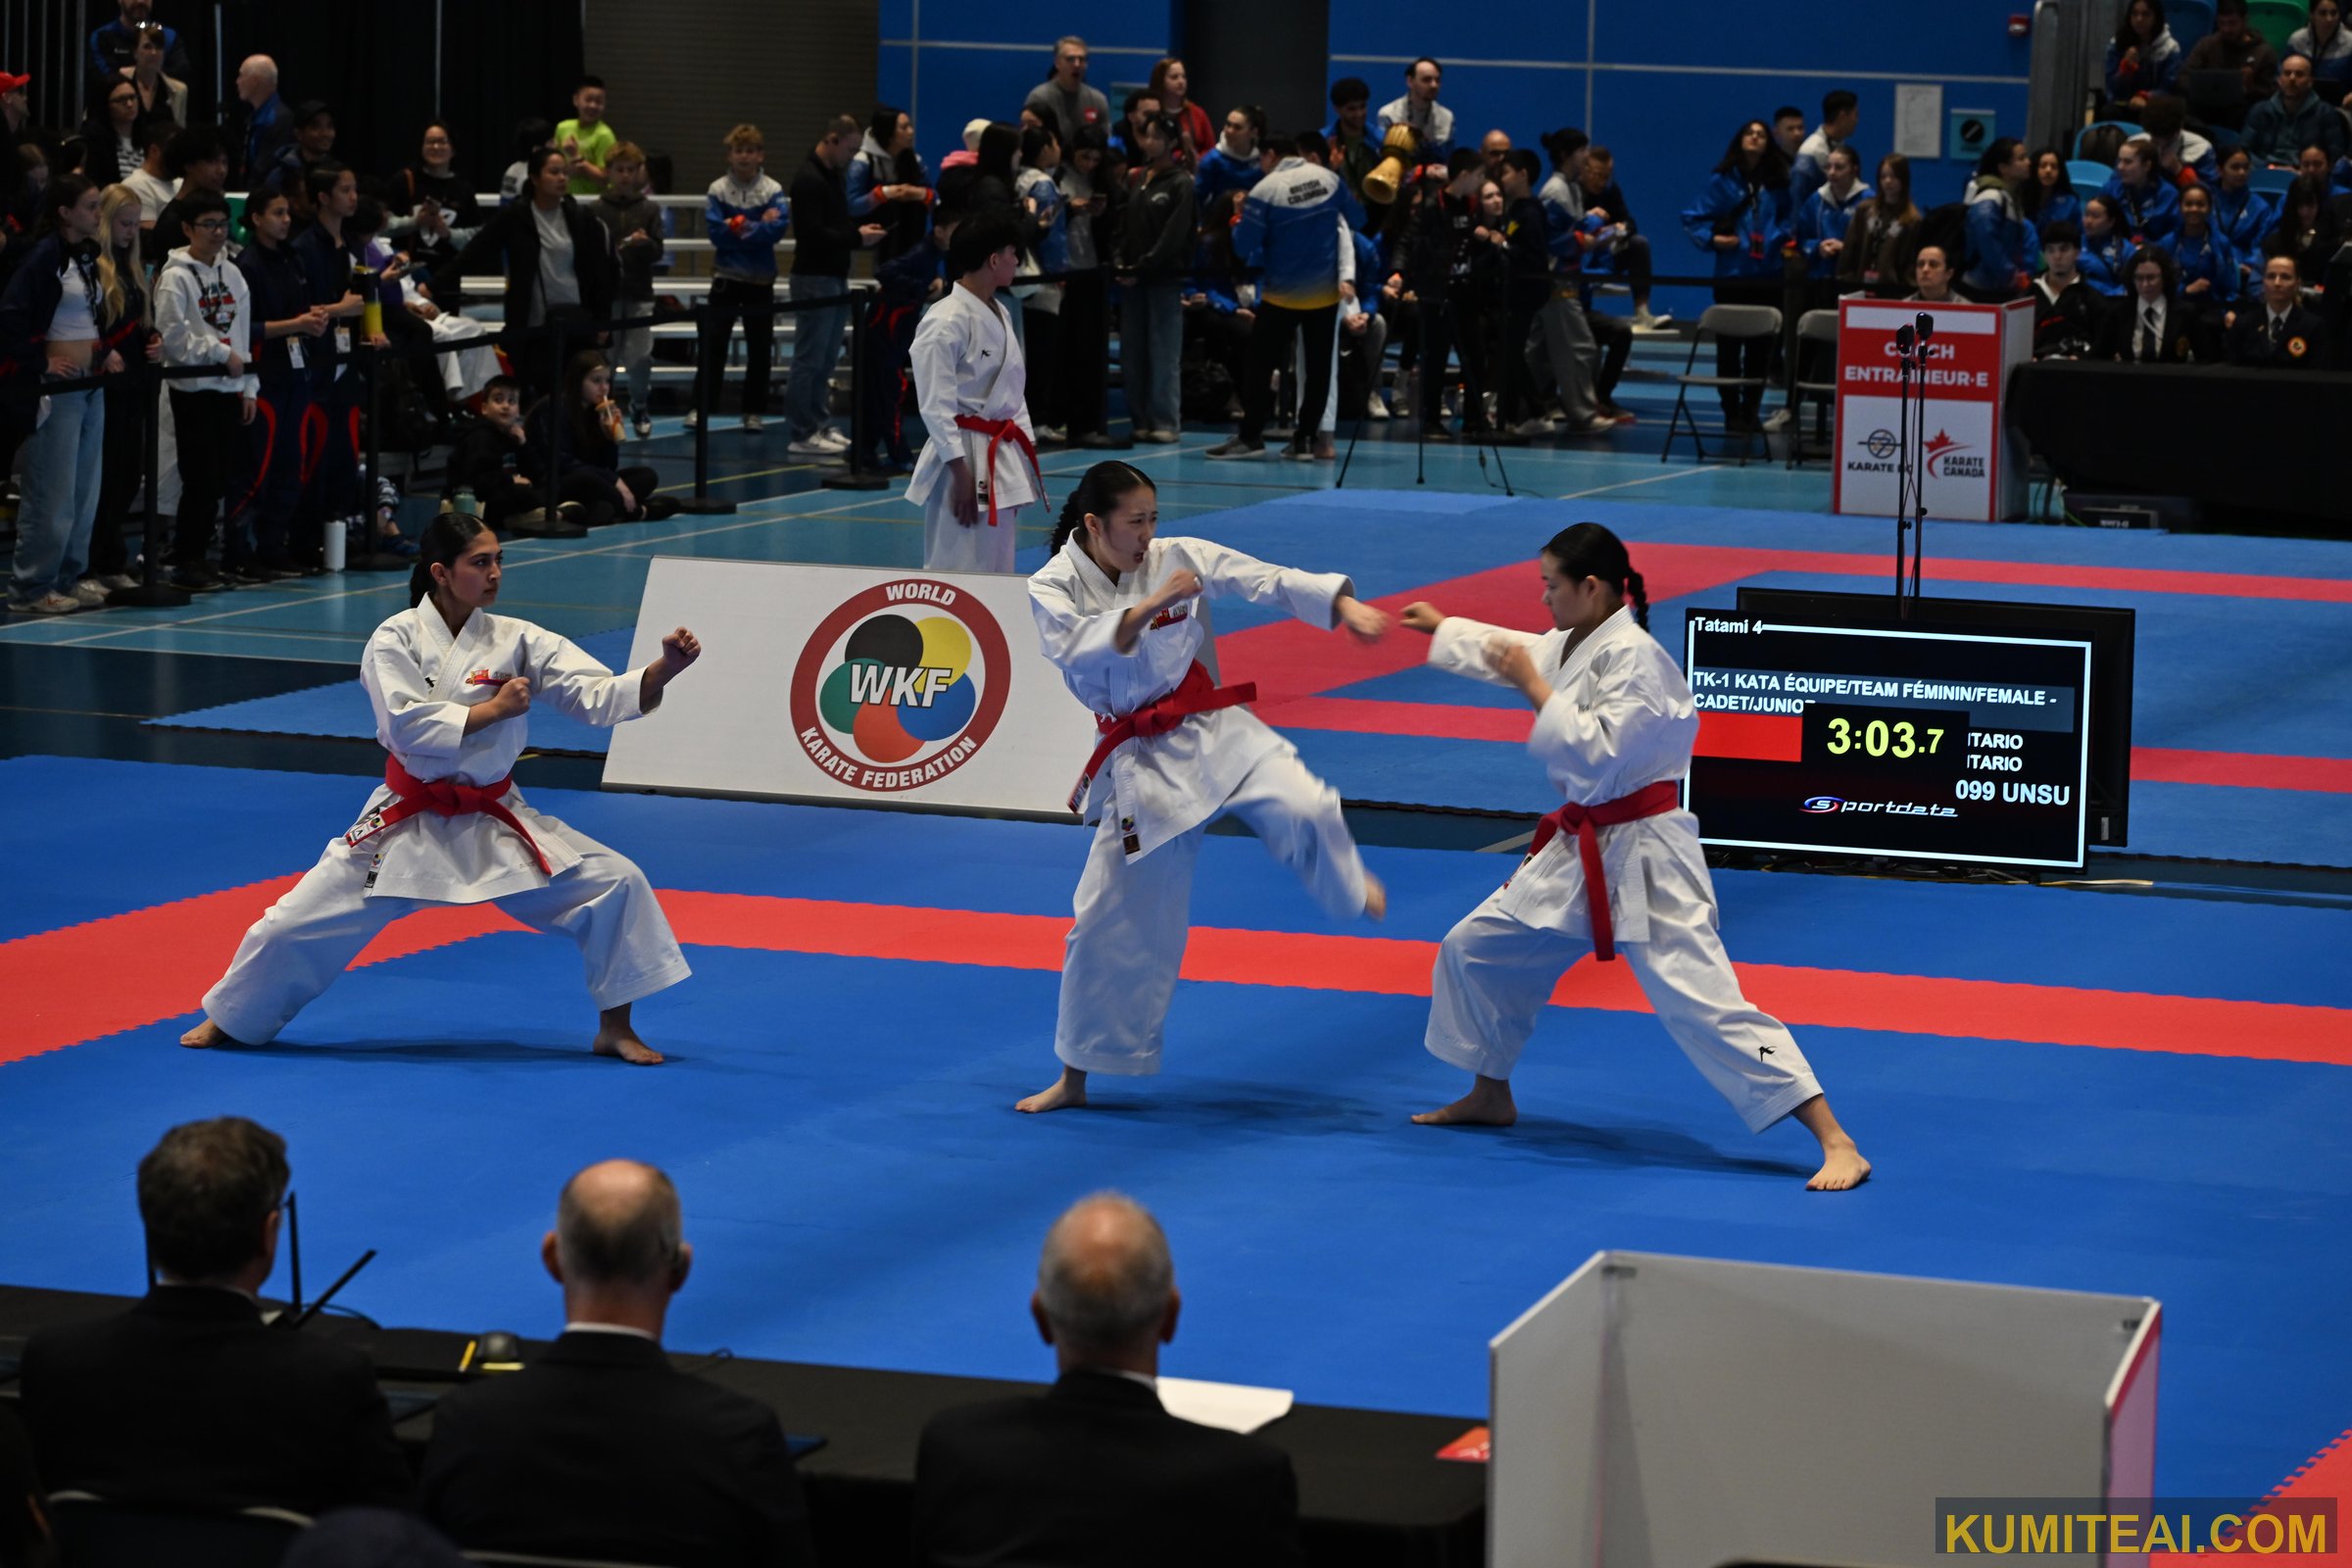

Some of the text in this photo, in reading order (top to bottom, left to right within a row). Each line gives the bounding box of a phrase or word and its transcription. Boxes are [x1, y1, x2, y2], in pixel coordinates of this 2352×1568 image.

[1884, 341, 1955, 360] CCH
[1847, 462, 1894, 472] KARATE
[1943, 466, 1985, 477] CANADA
[1944, 456, 1984, 467] KARATE
[886, 582, 956, 607] WORLD
[1694, 616, 1763, 635] Tatami 4
[850, 662, 953, 709] WKF
[1693, 671, 1730, 688] TK-1
[1735, 673, 1781, 690] KATA
[1785, 673, 1898, 697] ÉQUIPE/TEAM
[1902, 680, 2046, 706] FÉMININ/FEMALE
[1692, 693, 1816, 714] CADET/JUNIO
[1826, 717, 1945, 759] 3:03.7
[800, 726, 977, 788] KARATE FEDERATION
[1955, 779, 2070, 806] 099 UNSU
